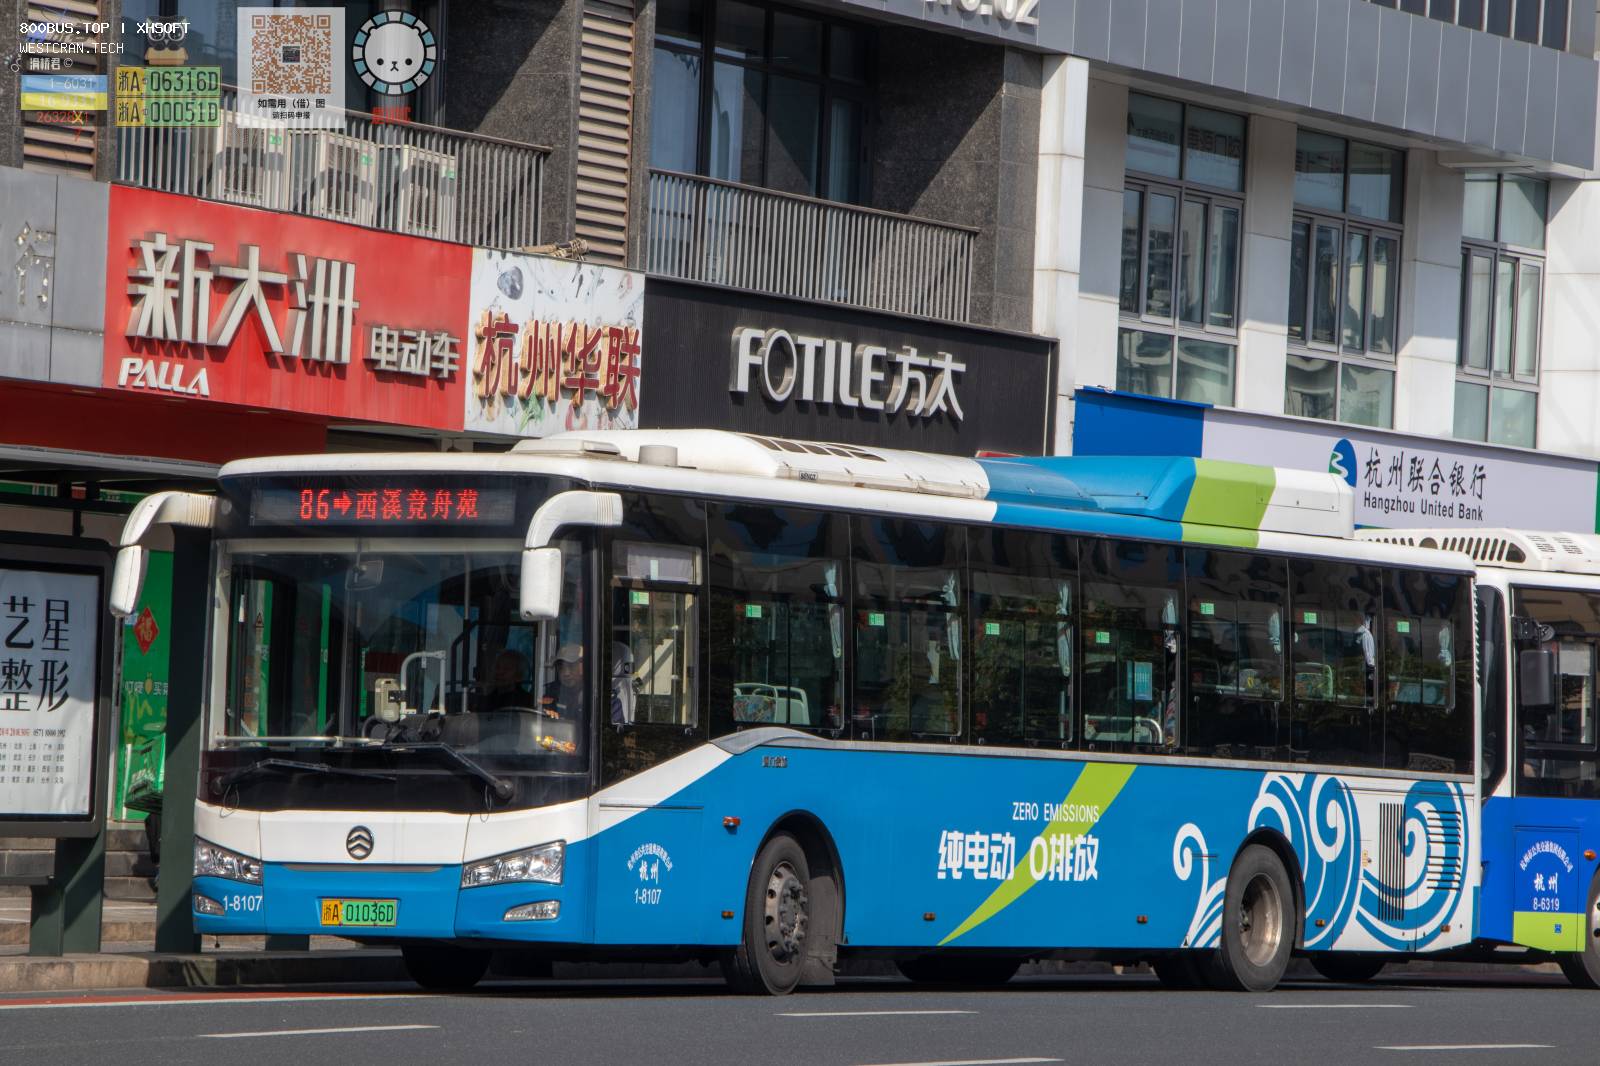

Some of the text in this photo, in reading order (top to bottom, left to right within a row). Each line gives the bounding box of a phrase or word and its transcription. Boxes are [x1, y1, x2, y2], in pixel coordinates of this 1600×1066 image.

[125, 231, 461, 379] 新大洲 电动车
[474, 310, 642, 412] 杭州华联
[729, 326, 967, 423] FOTILE 方太
[1363, 446, 1486, 500] 杭州联合银行
[300, 489, 329, 520] 86
[1363, 491, 1484, 521] Hangzhou United Bank
[1, 595, 71, 652] 艺星
[0, 658, 70, 713] 整形
[1012, 802, 1099, 823] ZERO EMISSIONS
[937, 830, 1015, 881] 纯电动
[634, 888, 662, 905] 1-8107
[1533, 872, 1558, 893] 杭州
[223, 895, 263, 911] 1-8107
[323, 903, 394, 922] 浙A 01036D
[1533, 897, 1560, 911] 8-6319
